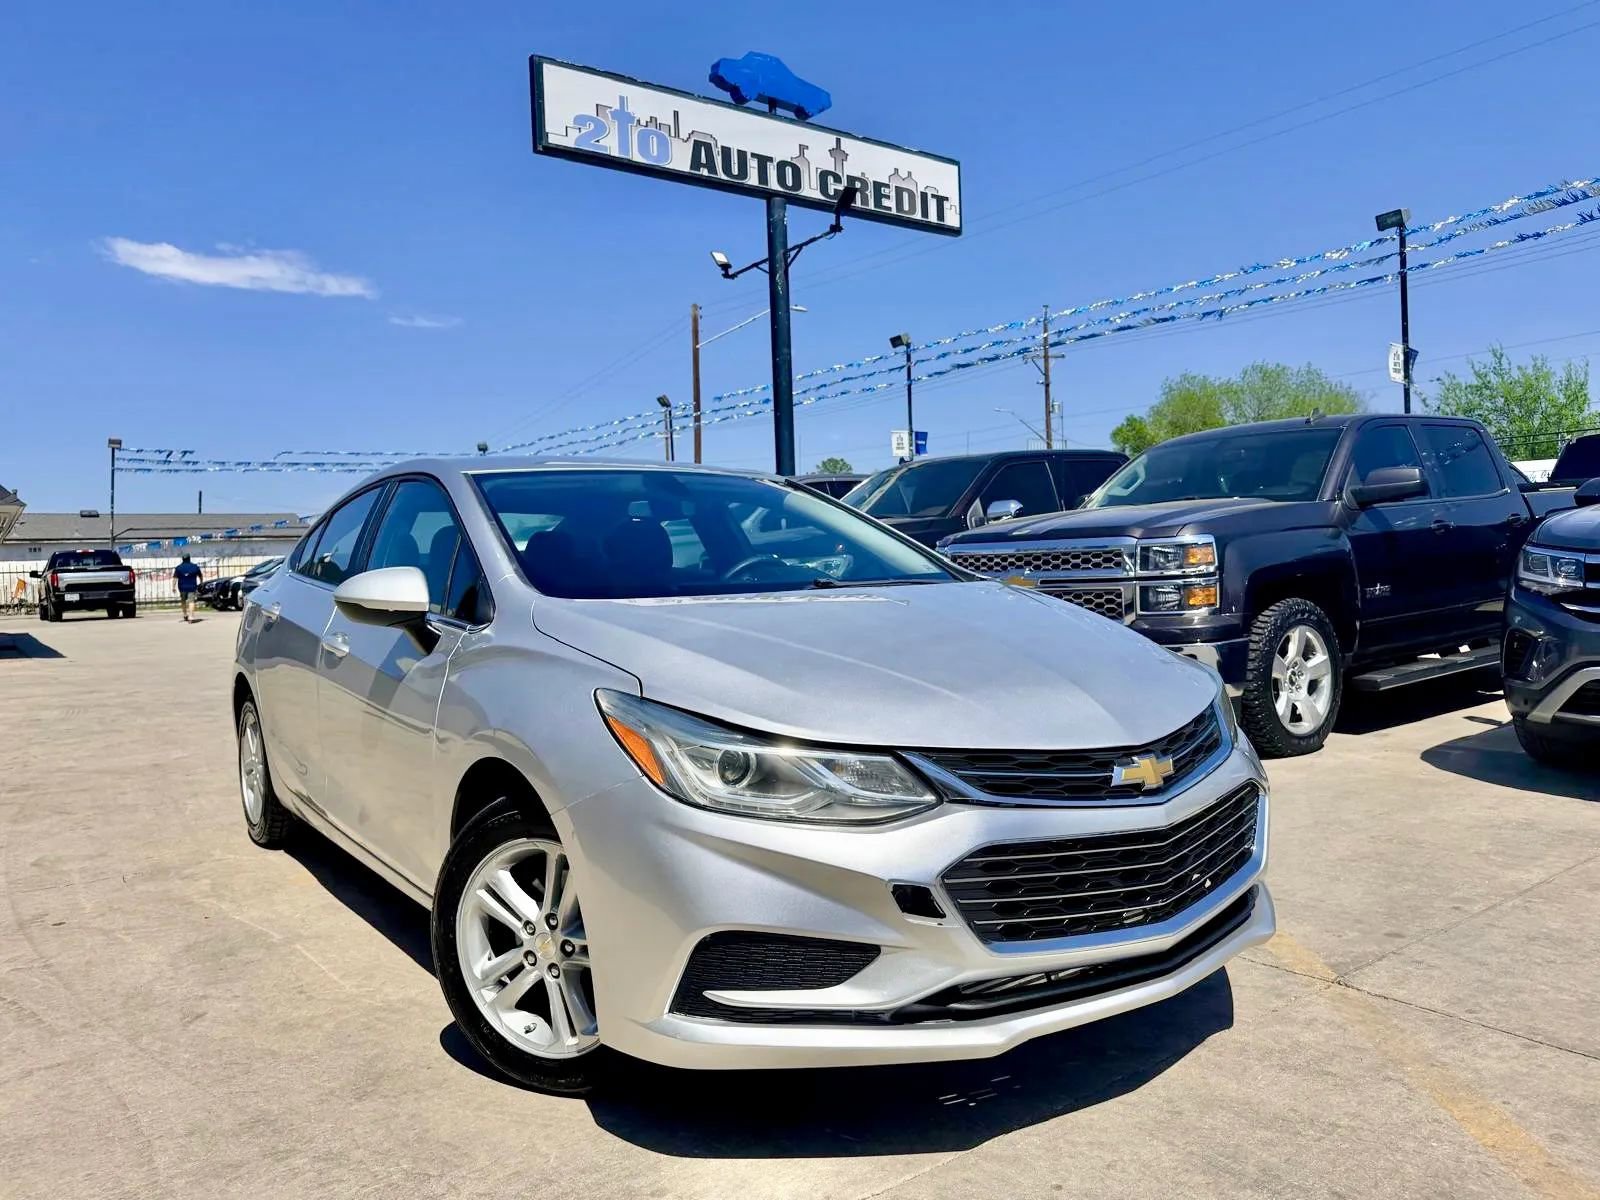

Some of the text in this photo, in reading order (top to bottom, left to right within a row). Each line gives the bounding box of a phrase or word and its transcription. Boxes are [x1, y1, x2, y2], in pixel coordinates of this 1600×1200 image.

[573, 95, 949, 223] 210 AUTO CREDIT
